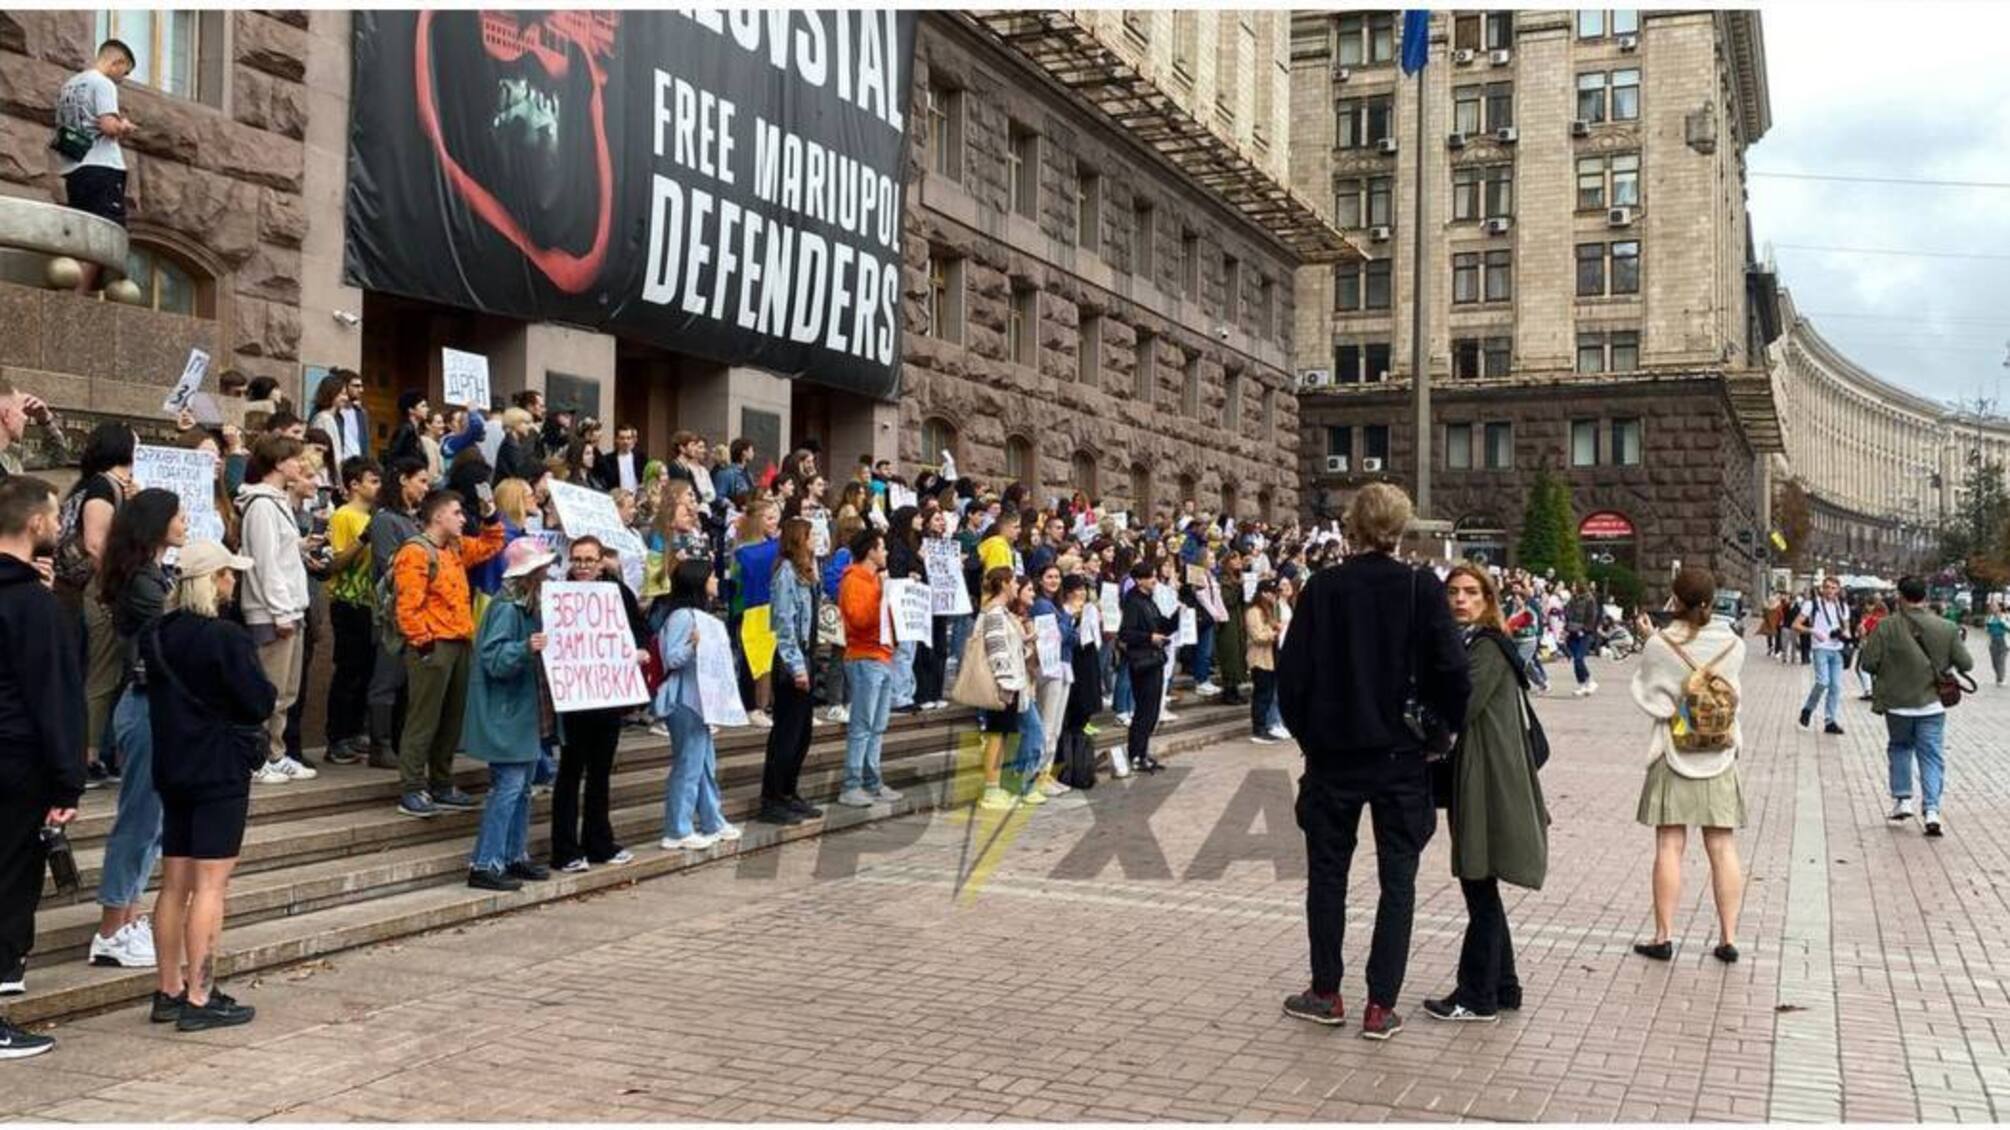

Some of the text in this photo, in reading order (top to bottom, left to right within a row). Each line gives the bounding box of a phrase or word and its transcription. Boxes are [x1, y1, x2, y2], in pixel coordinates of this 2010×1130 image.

[653, 67, 900, 254] FREE MARIUPOL
[641, 173, 898, 367] DEFENDERS
[551, 663, 641, 701] БРУКІВКИ
[553, 631, 632, 661] ЗАМІСТЬ
